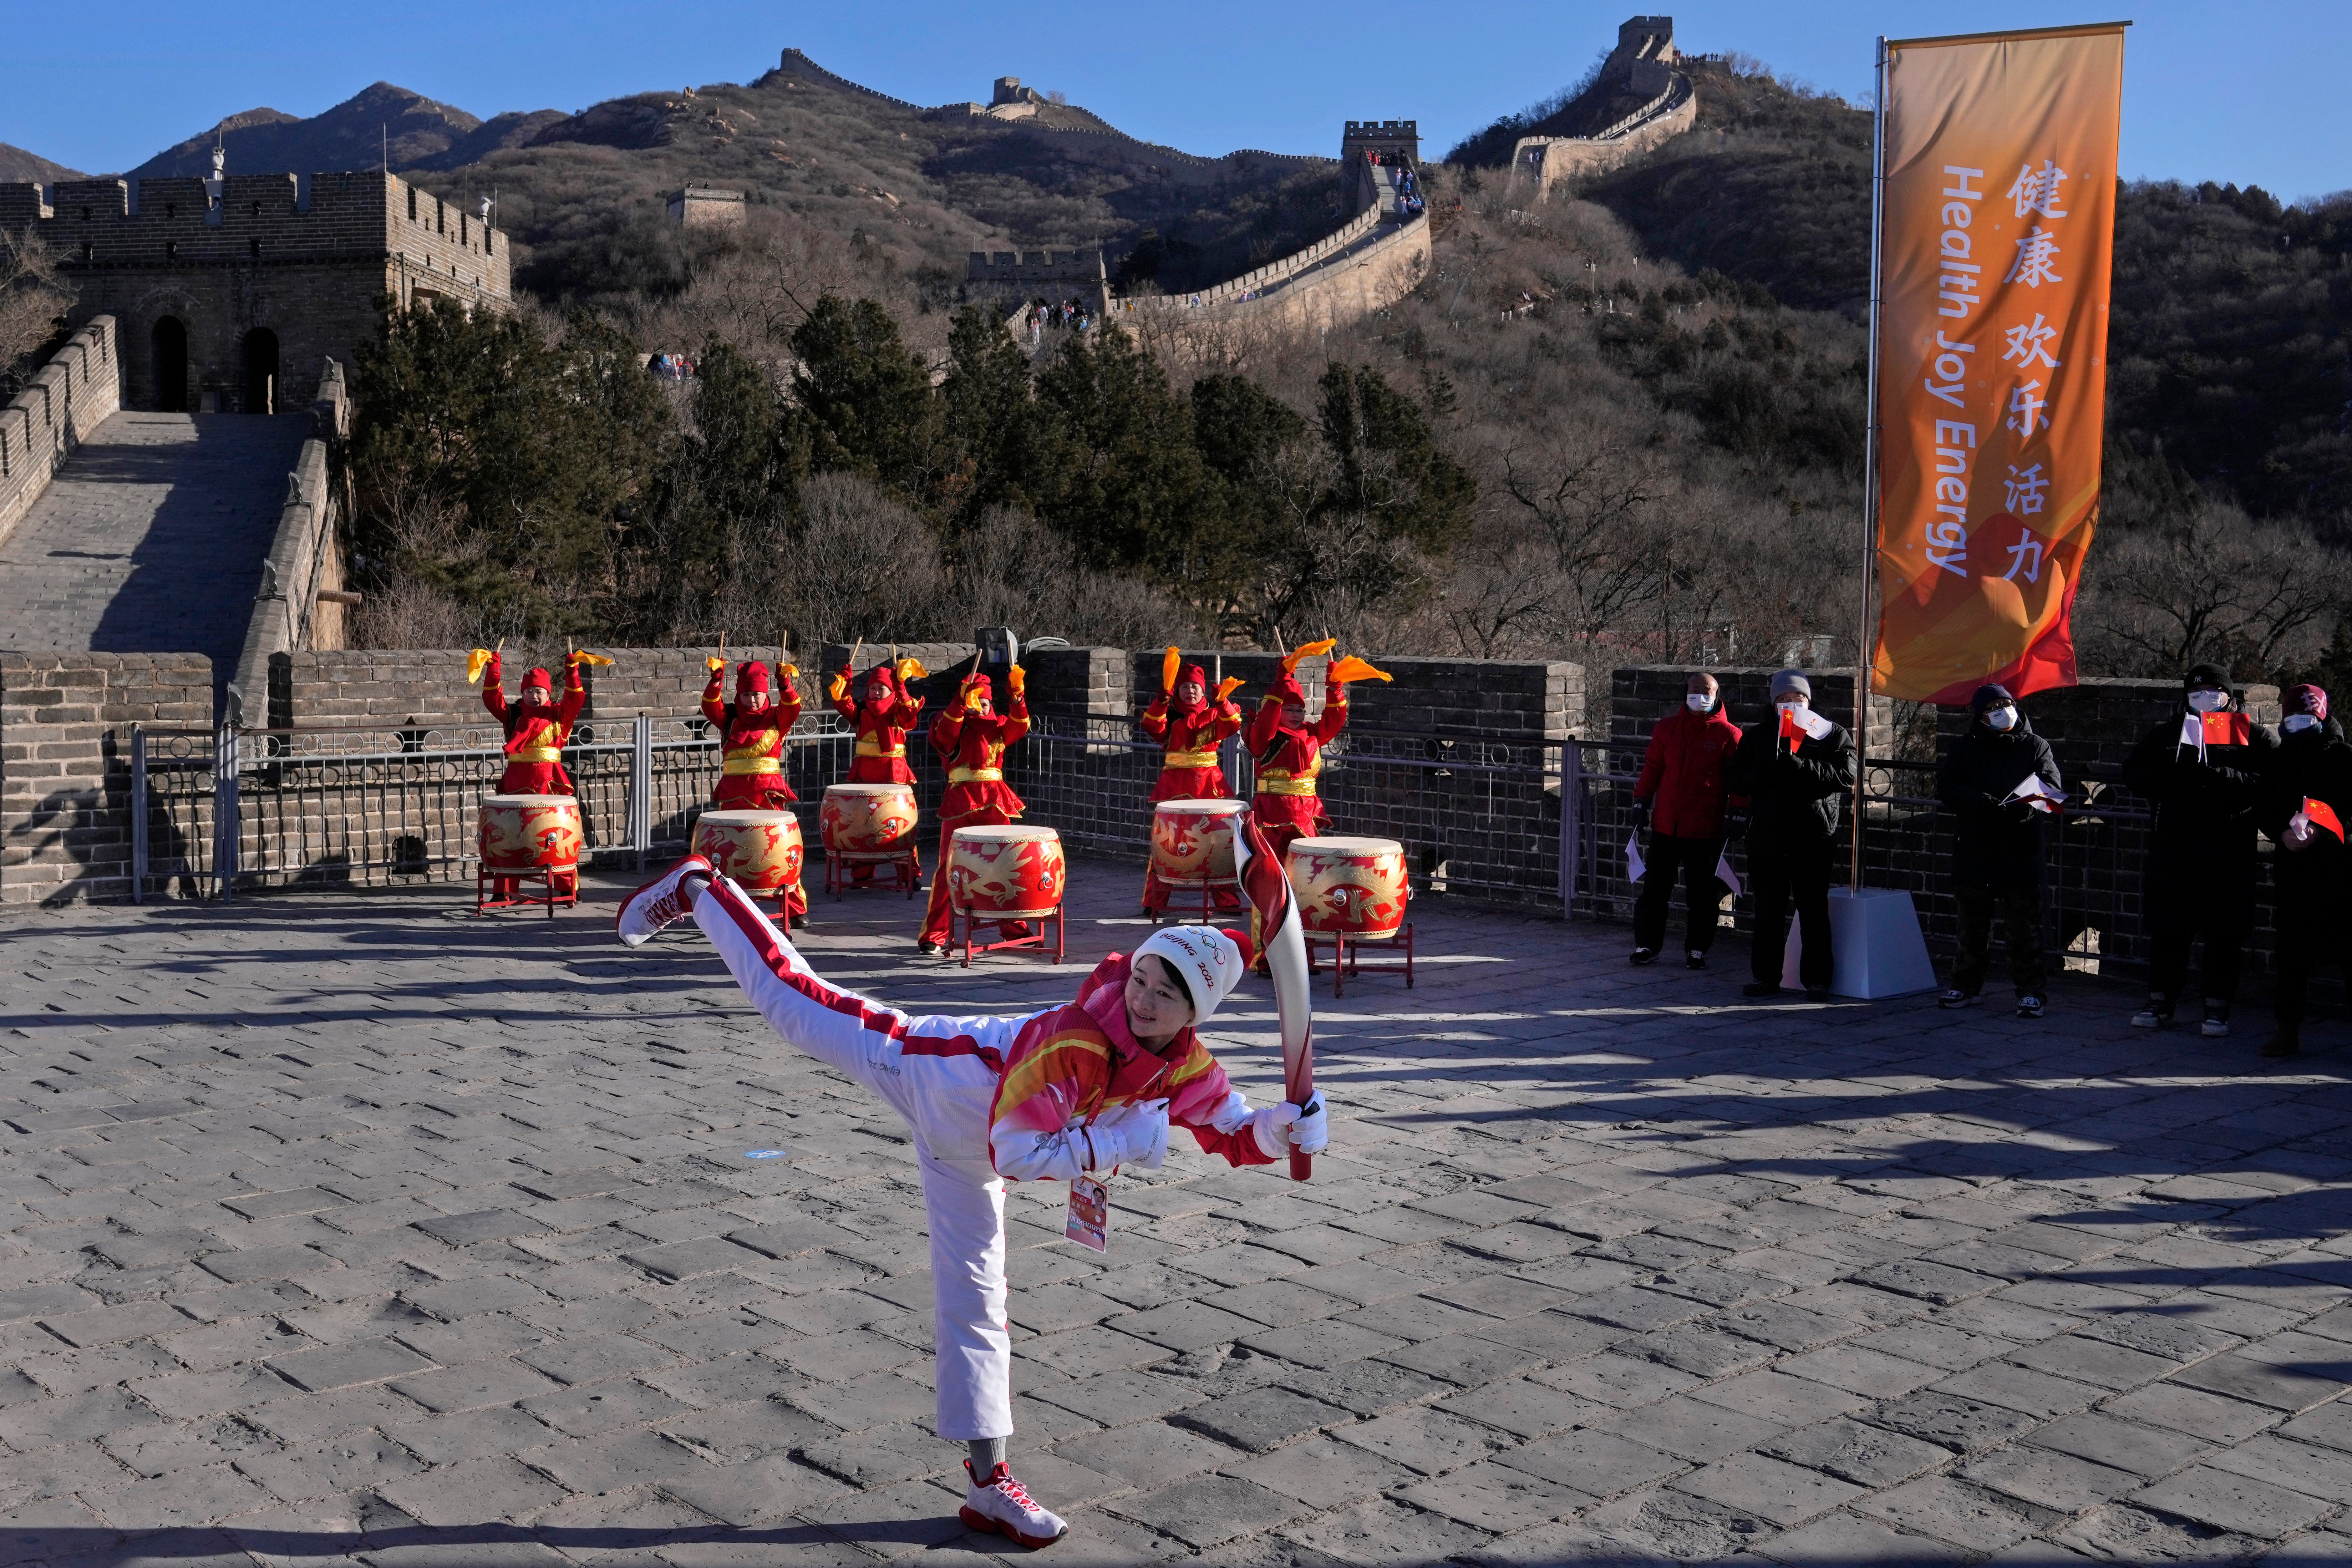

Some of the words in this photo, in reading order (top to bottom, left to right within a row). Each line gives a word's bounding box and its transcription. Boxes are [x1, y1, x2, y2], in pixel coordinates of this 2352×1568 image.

[1939, 165, 1983, 318] Health
[2003, 159, 2068, 288] 健康
[1925, 330, 1975, 408] Joy
[2002, 313, 2061, 437] 欢乐
[1926, 420, 1975, 577] Energy
[2002, 463, 2049, 583] 活力
[1159, 933, 1197, 956] BEIJING
[1198, 962, 1214, 991] 2022
[879, 1063, 900, 1076] EIJING
[1150, 1125, 1160, 1149] BEIJING
